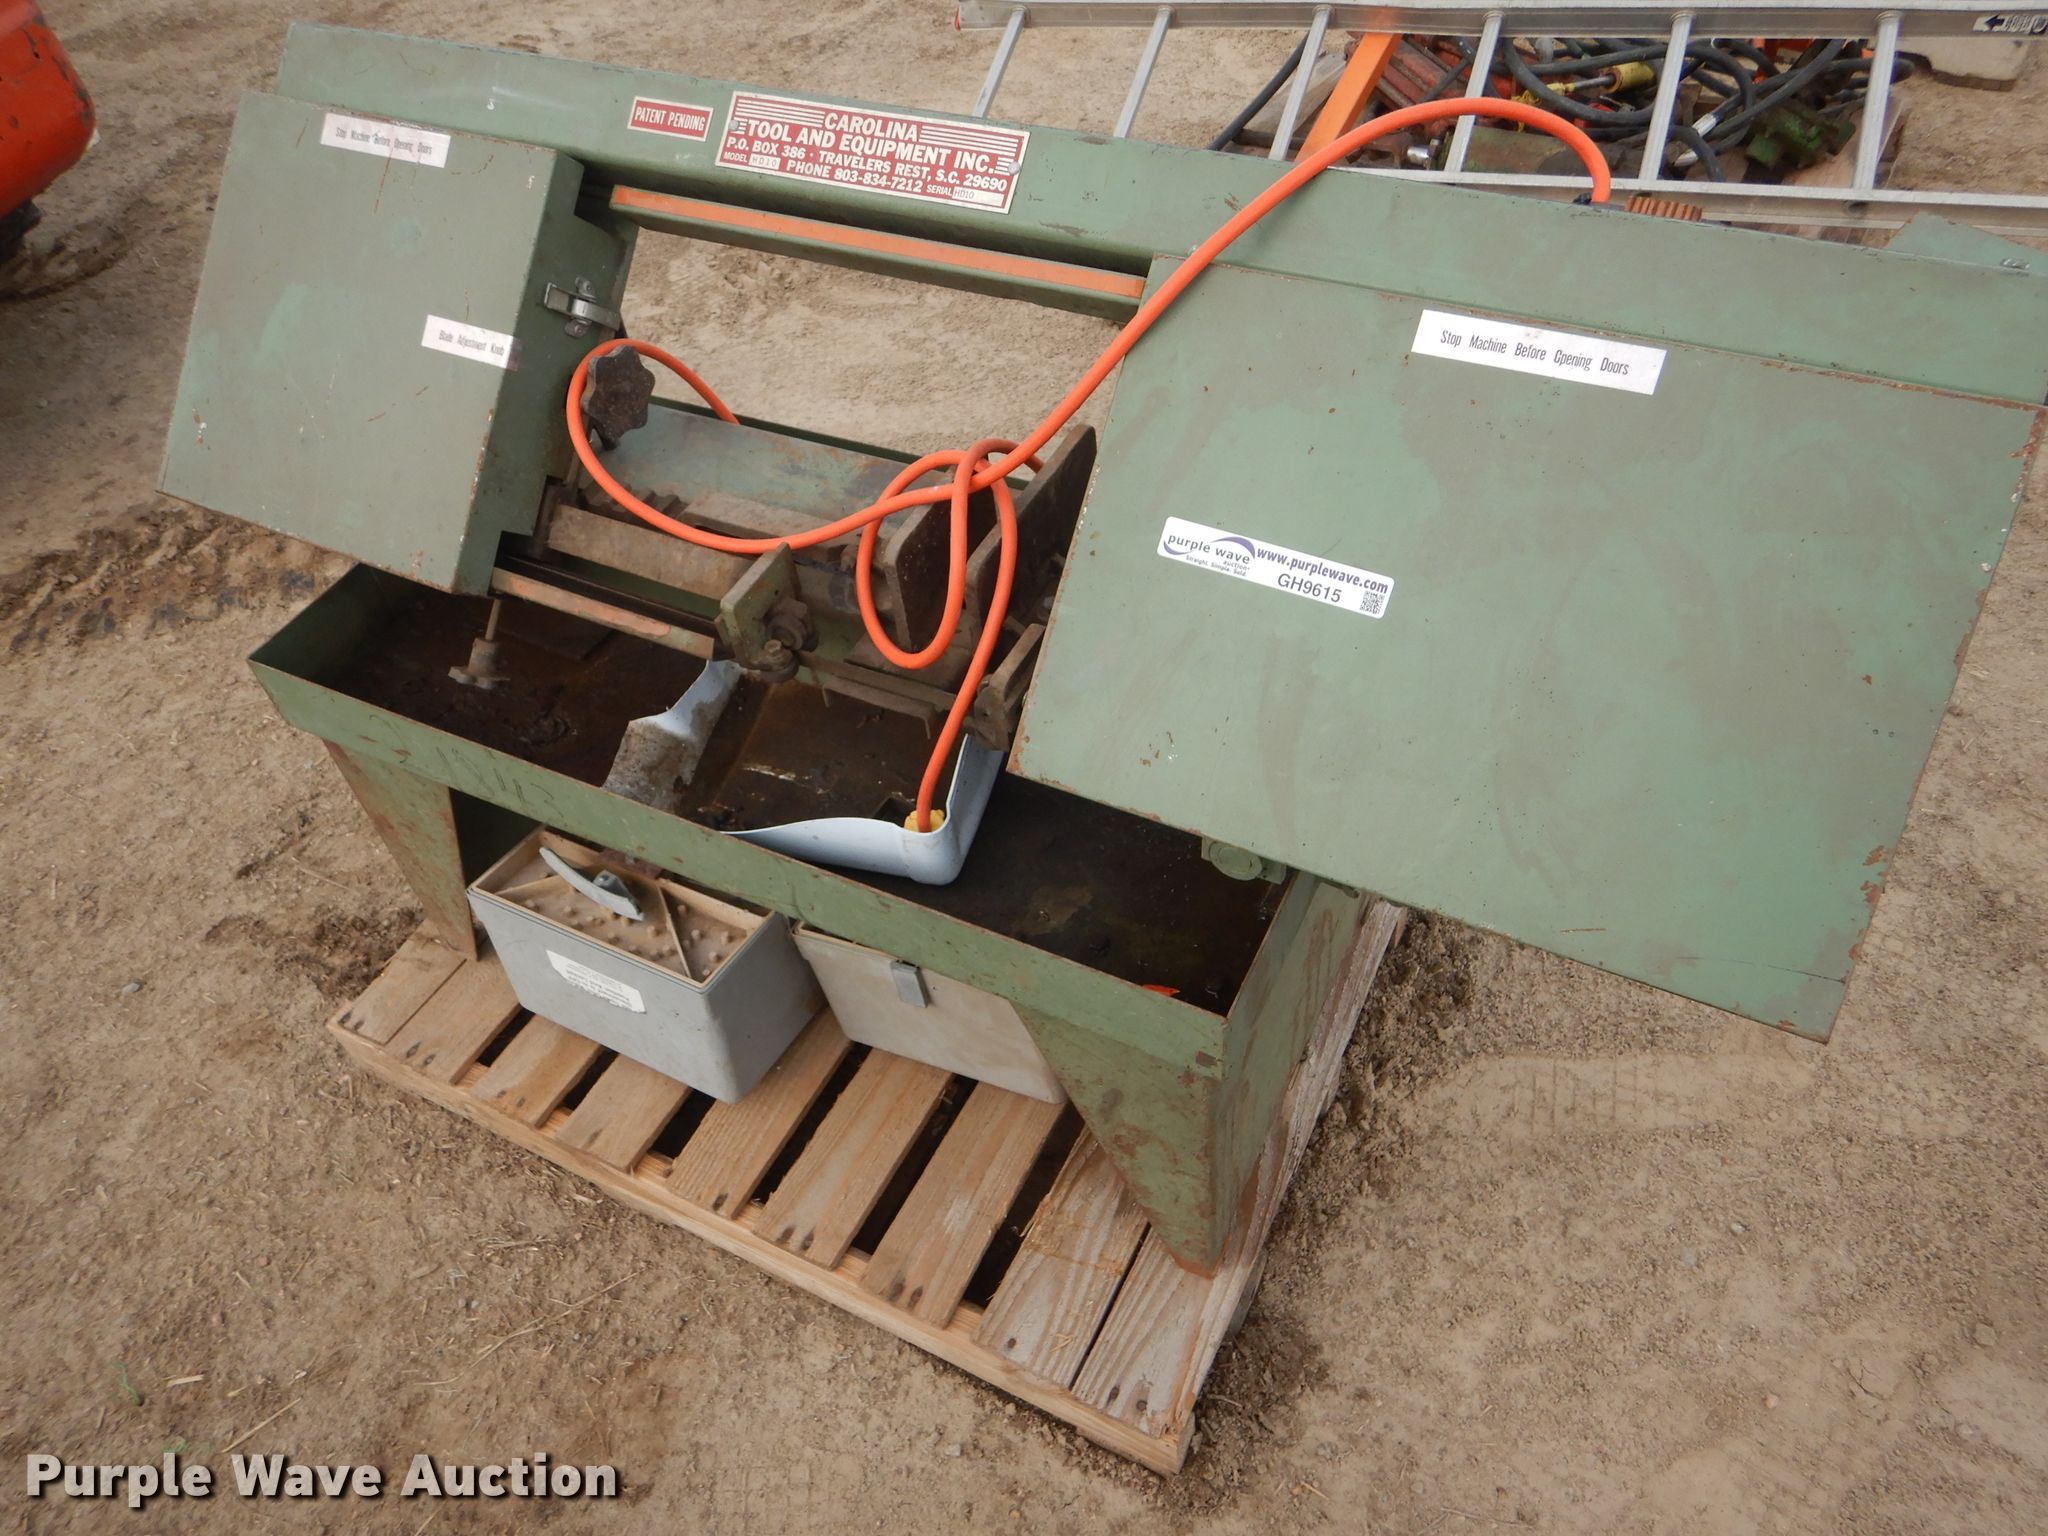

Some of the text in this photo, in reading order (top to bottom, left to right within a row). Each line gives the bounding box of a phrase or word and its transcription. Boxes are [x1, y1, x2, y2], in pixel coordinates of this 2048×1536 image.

[634, 106, 706, 131] PATENT PENDING
[824, 112, 918, 142] CAROLINA
[726, 136, 1007, 192] P.O. BOX 386 TRAVELERS REST, S.C. 29690
[748, 119, 995, 174] TOOL AND EQUIPMENT INC.
[724, 151, 748, 163] MODEL
[786, 159, 832, 178] PHONE
[834, 167, 923, 193] 803-834-7212
[926, 183, 952, 197] SERIAL
[1440, 329, 1462, 348] Stop
[1469, 334, 1507, 354] Machine
[1514, 342, 1547, 361] Before
[1600, 357, 1630, 376] Doors
[1167, 534, 1251, 565] purple wave
[1257, 547, 1388, 594] www.purplewave.com
[1277, 572, 1342, 603] GH9615
